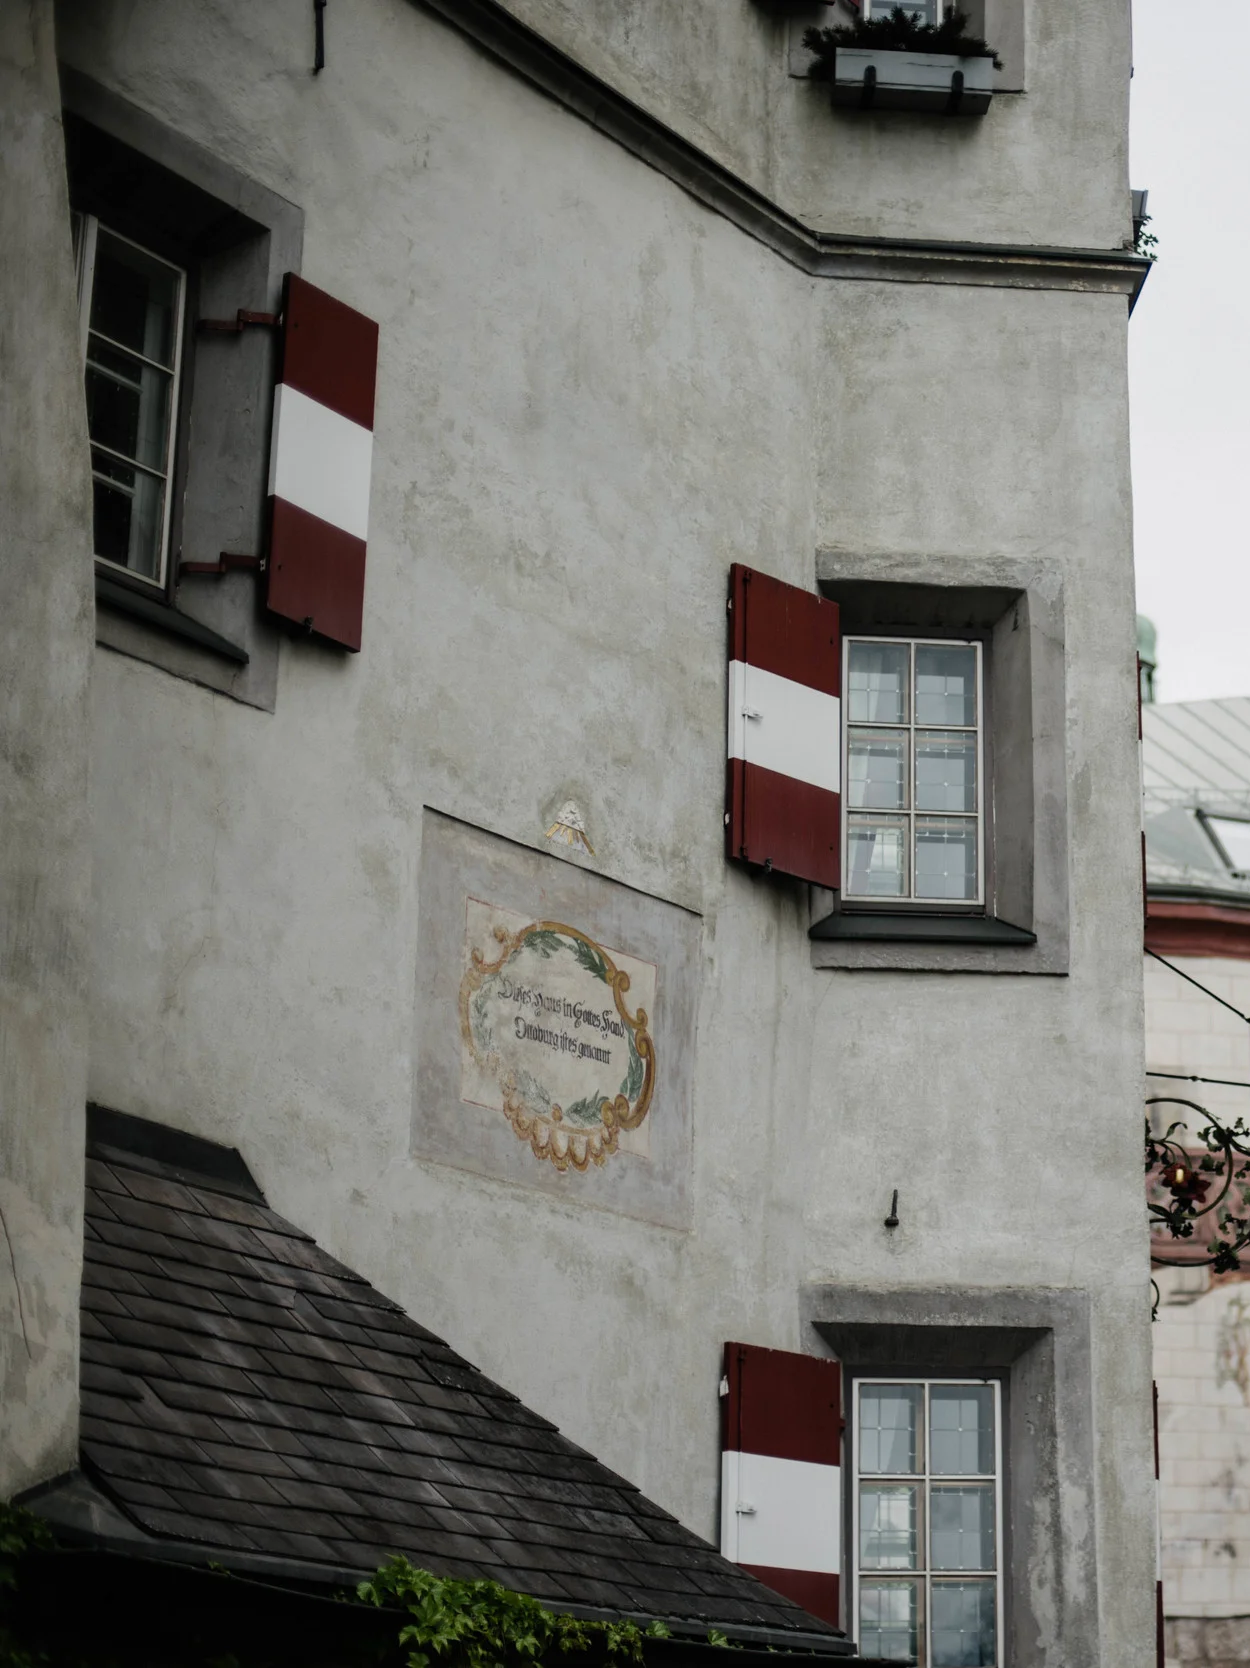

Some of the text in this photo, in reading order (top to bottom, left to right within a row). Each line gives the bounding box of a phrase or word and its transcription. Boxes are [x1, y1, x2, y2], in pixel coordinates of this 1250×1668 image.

[563, 998, 573, 1018] in
[573, 1000, 601, 1028] Gottes
[514, 1016, 559, 1051] Ottoburg
